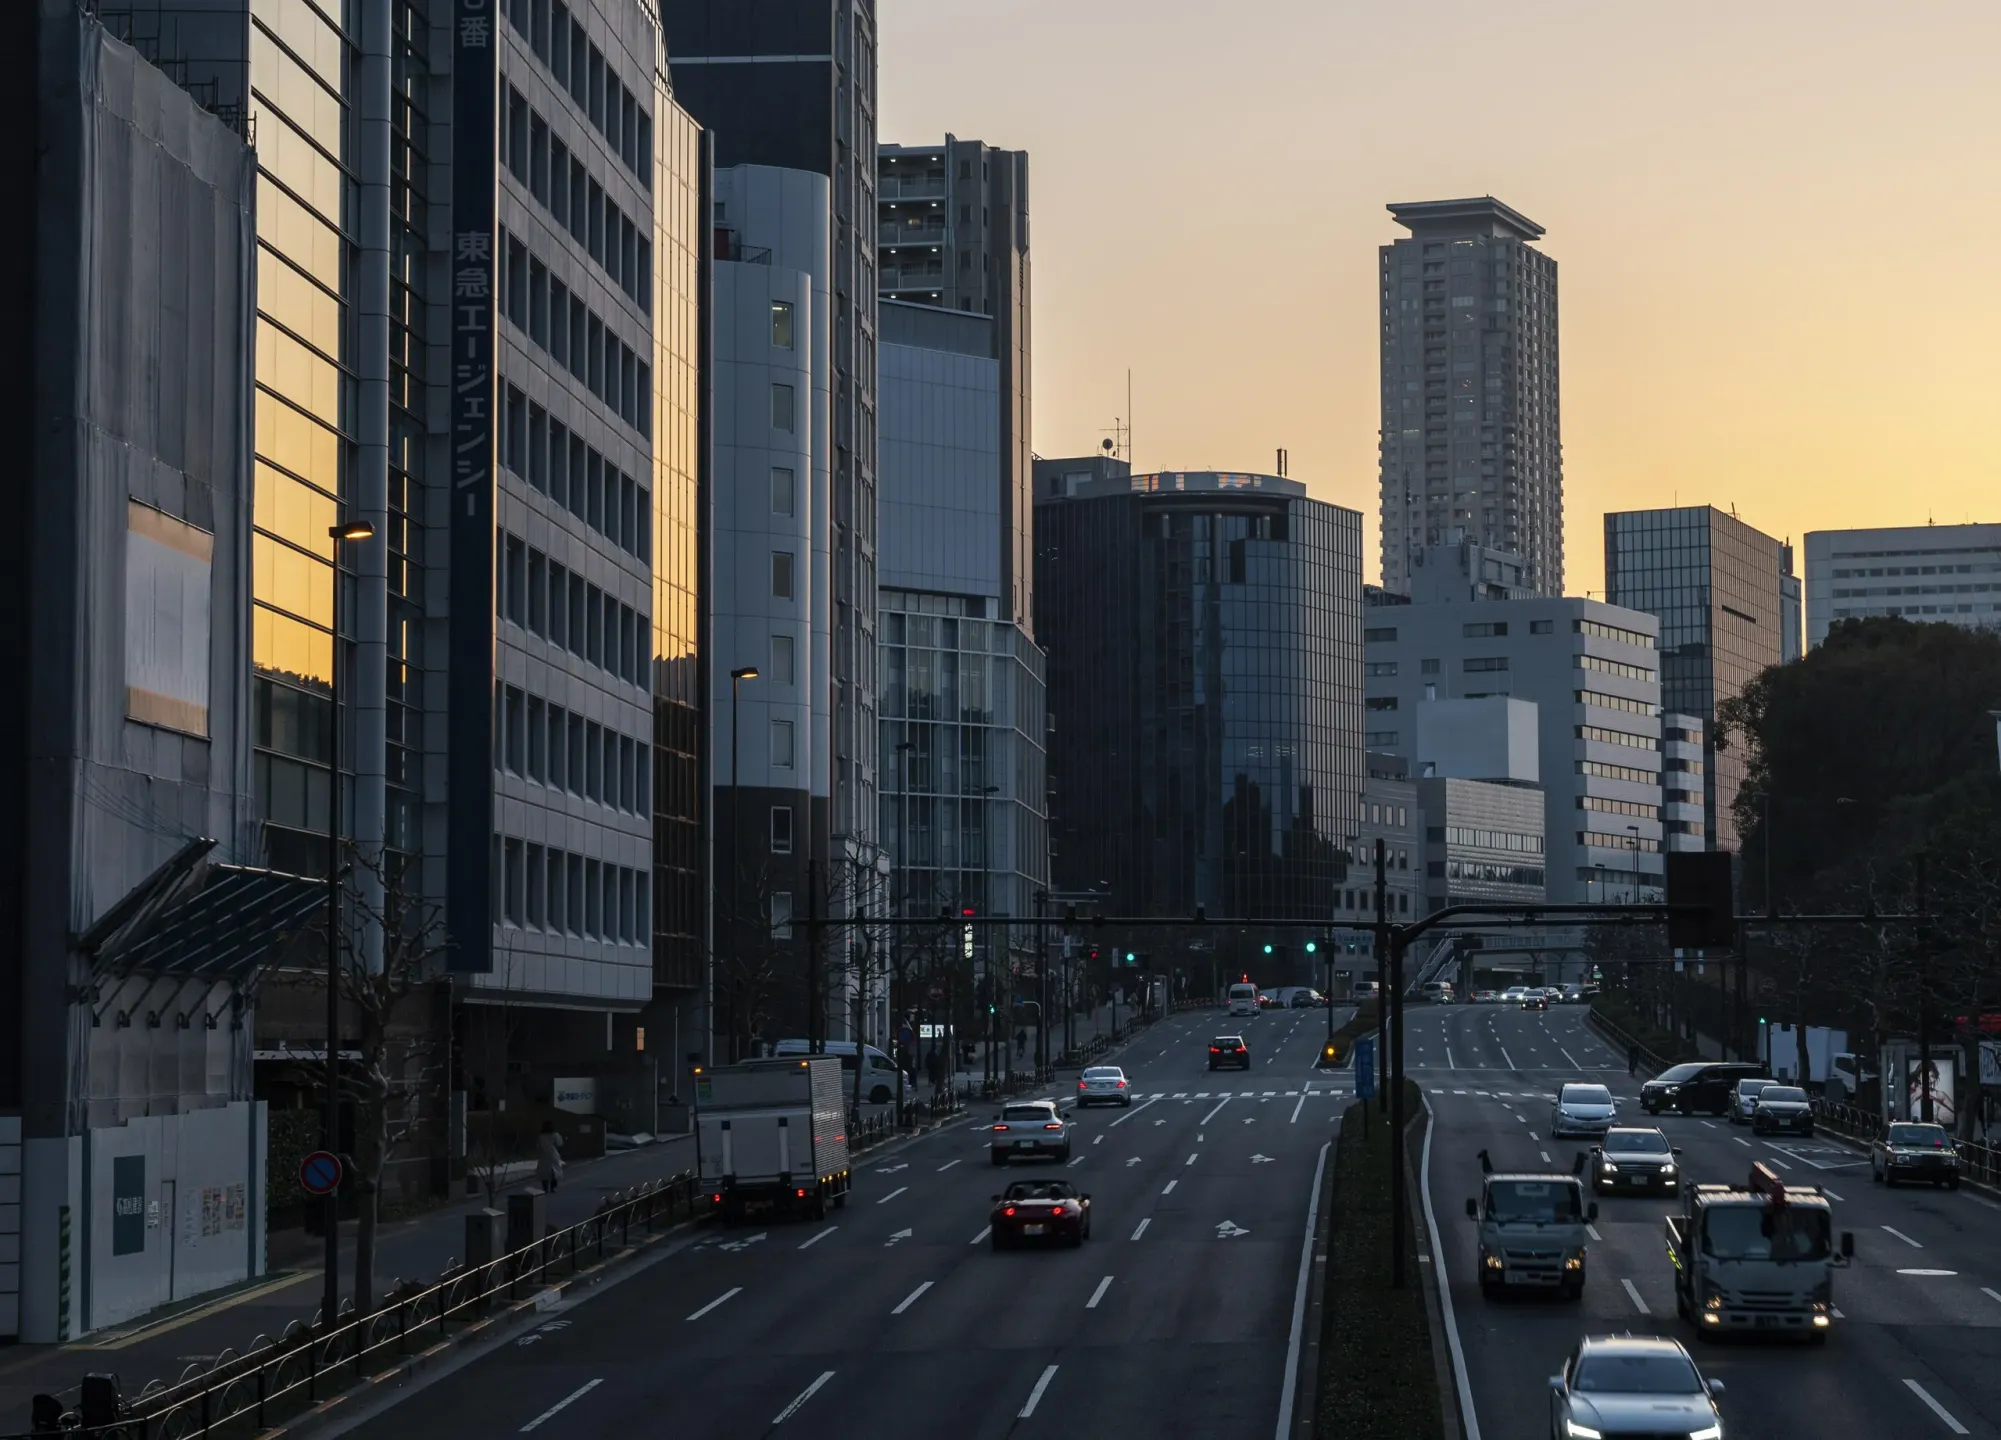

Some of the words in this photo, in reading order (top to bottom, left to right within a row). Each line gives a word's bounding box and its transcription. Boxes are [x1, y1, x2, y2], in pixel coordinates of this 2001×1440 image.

[455, 230, 490, 516] 東急エージェンシー
